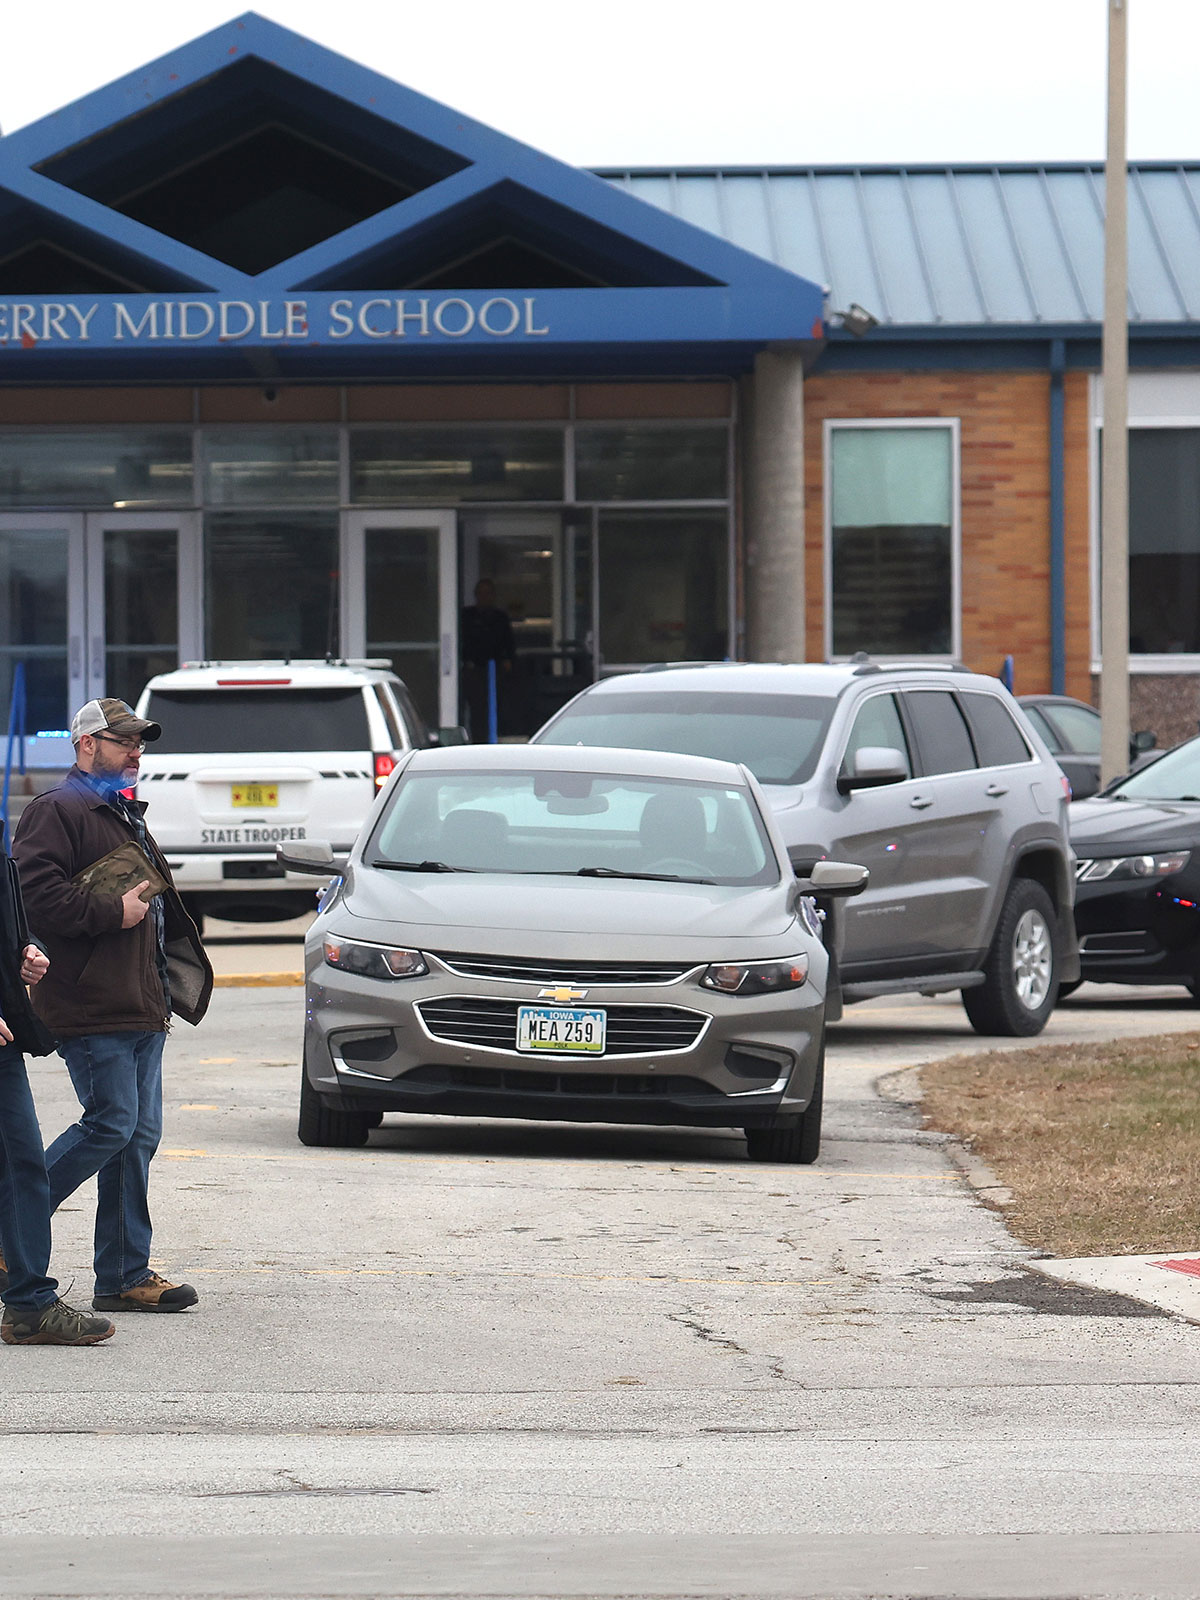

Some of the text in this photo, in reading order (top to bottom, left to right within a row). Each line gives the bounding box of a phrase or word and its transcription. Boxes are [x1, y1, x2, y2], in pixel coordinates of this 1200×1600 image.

[113, 300, 309, 339] MIDDLE
[329, 298, 549, 338] SCHOOL
[201, 827, 307, 843] STATE TROOPER
[549, 1012, 575, 1020] IOWA
[529, 1020, 593, 1042] MEA 259
